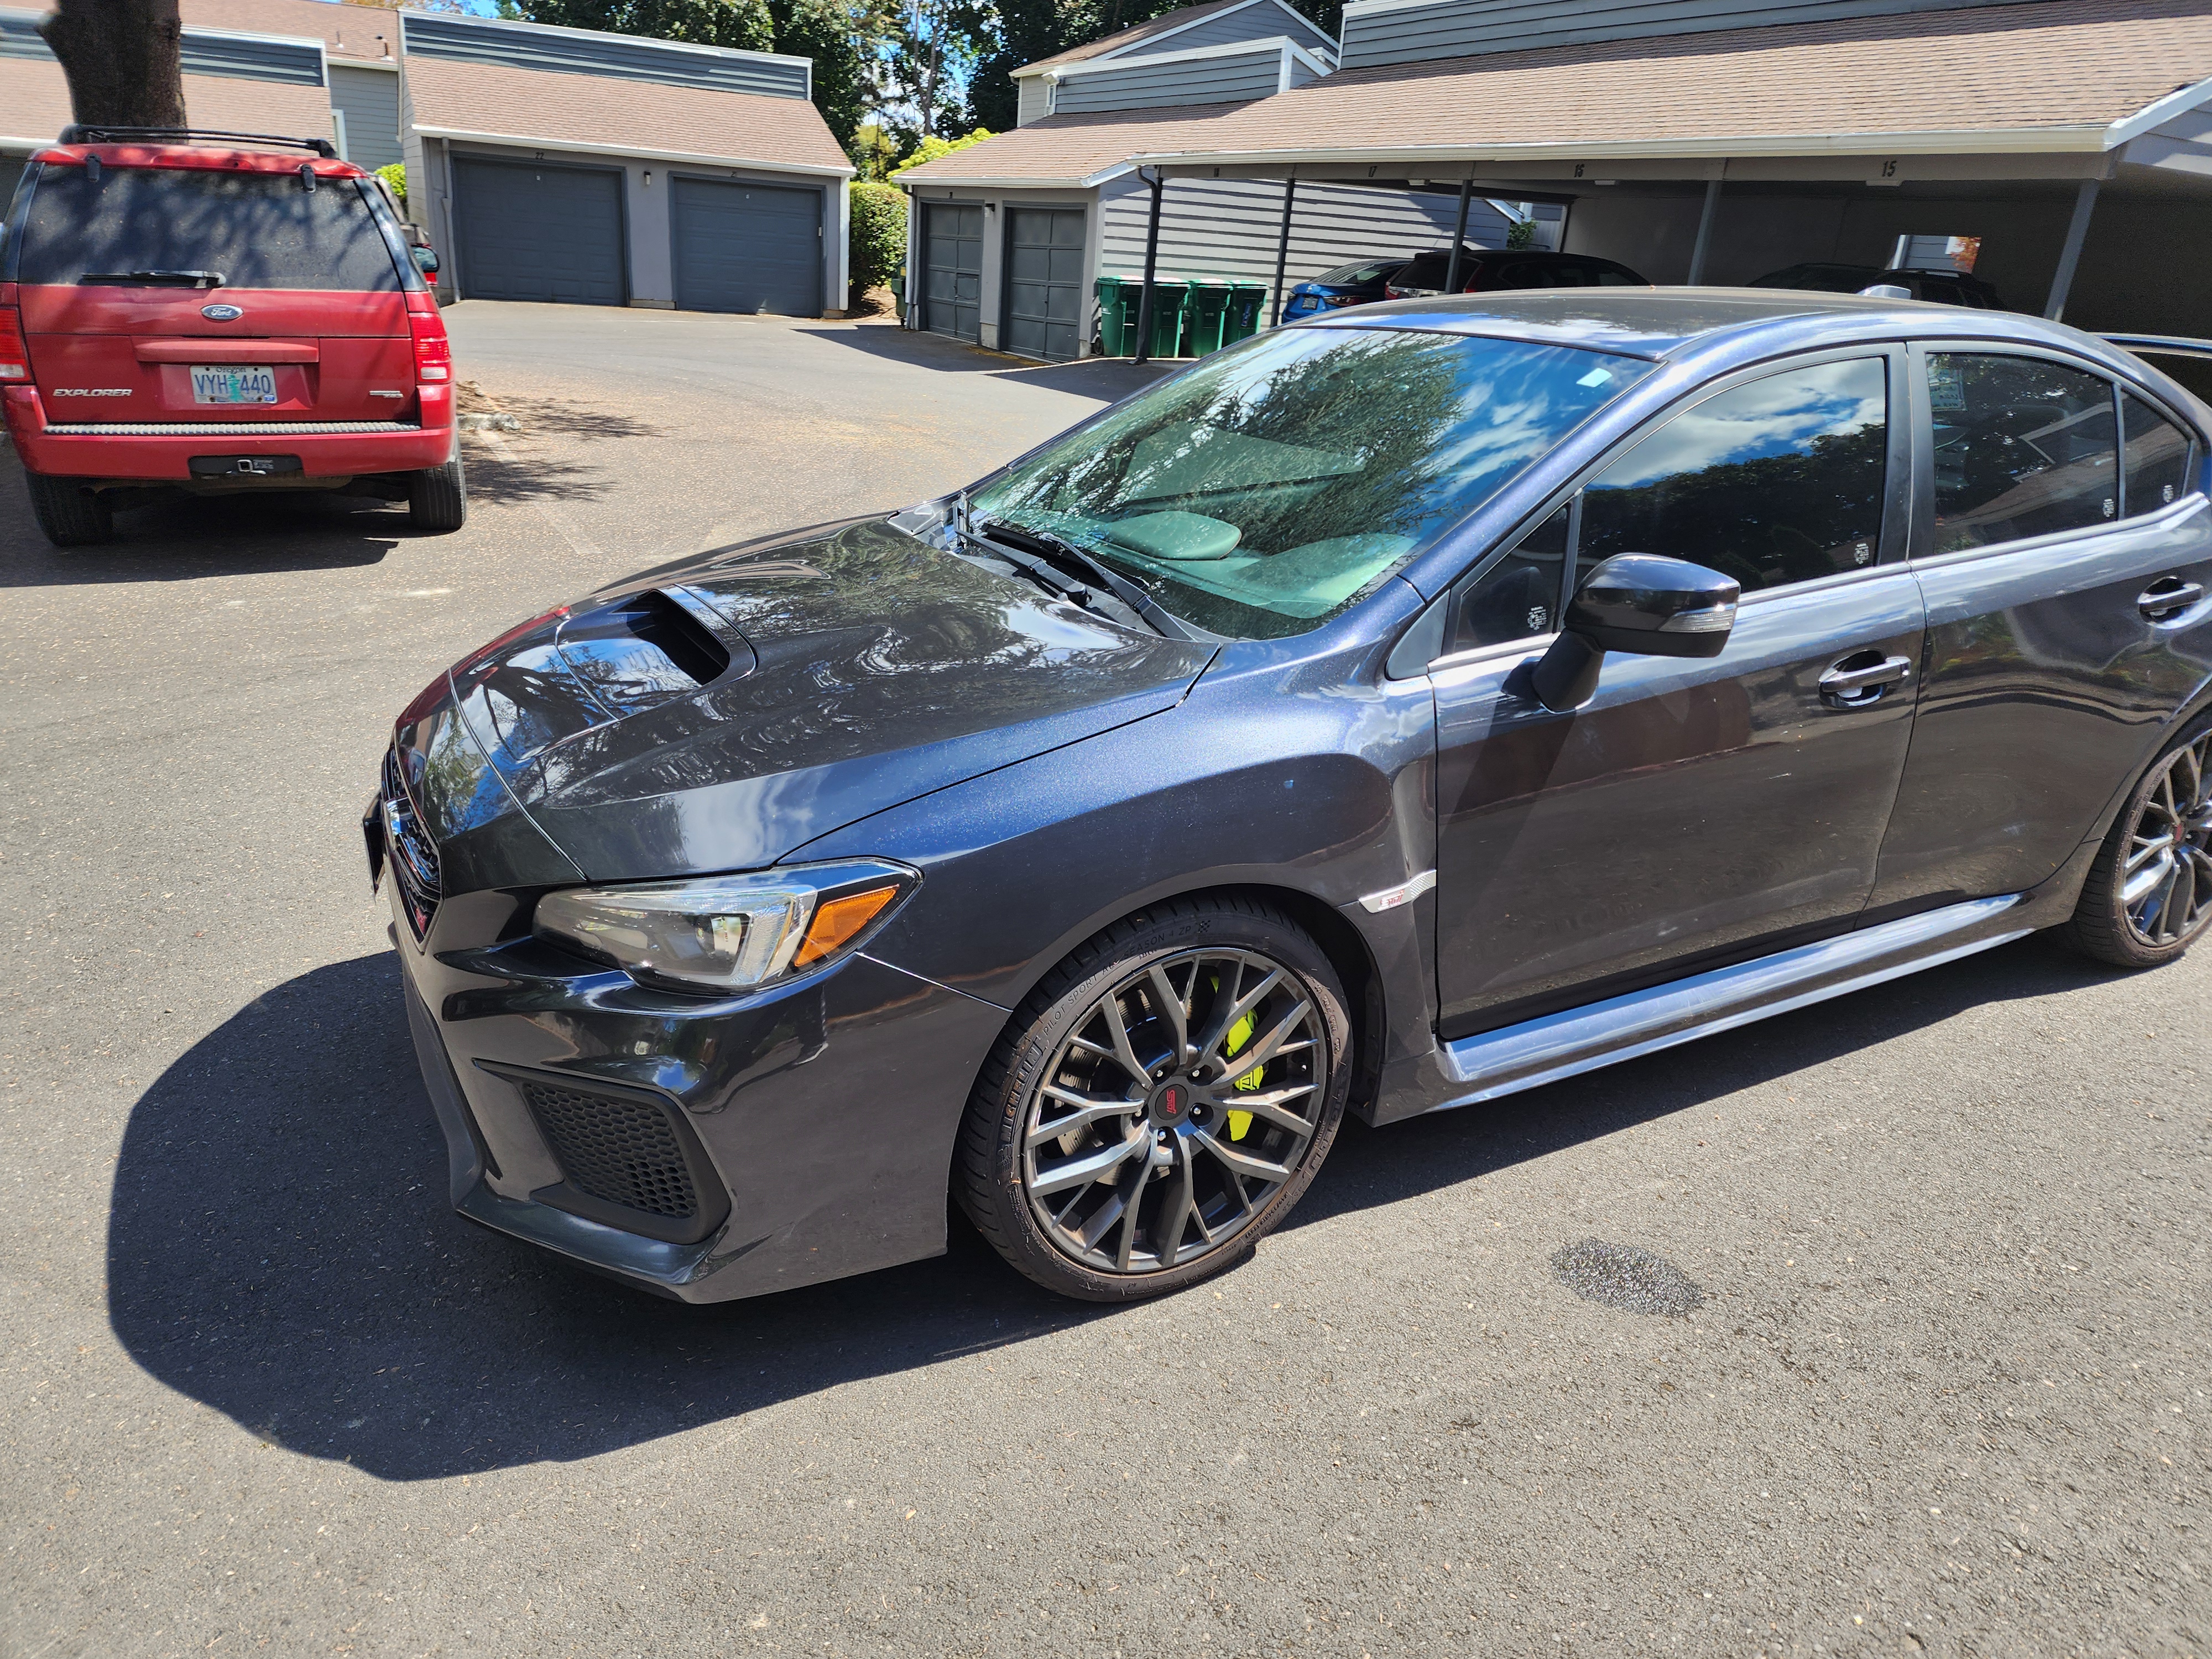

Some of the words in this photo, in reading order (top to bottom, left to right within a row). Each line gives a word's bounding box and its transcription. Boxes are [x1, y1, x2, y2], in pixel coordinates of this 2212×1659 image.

[1368, 165, 1378, 178] 17
[1882, 160, 1897, 177] 15
[211, 307, 232, 317] Ford
[216, 366, 247, 374] Oregon
[195, 374, 228, 394] VYH
[240, 374, 271, 394] 440
[1042, 1003, 1067, 1037] PILOT
[1068, 973, 1098, 1006] SPORT
[1123, 932, 1165, 958] SEASON
[1178, 925, 1191, 936] ZP
[1000, 1045, 1041, 1142] MICHELIN
